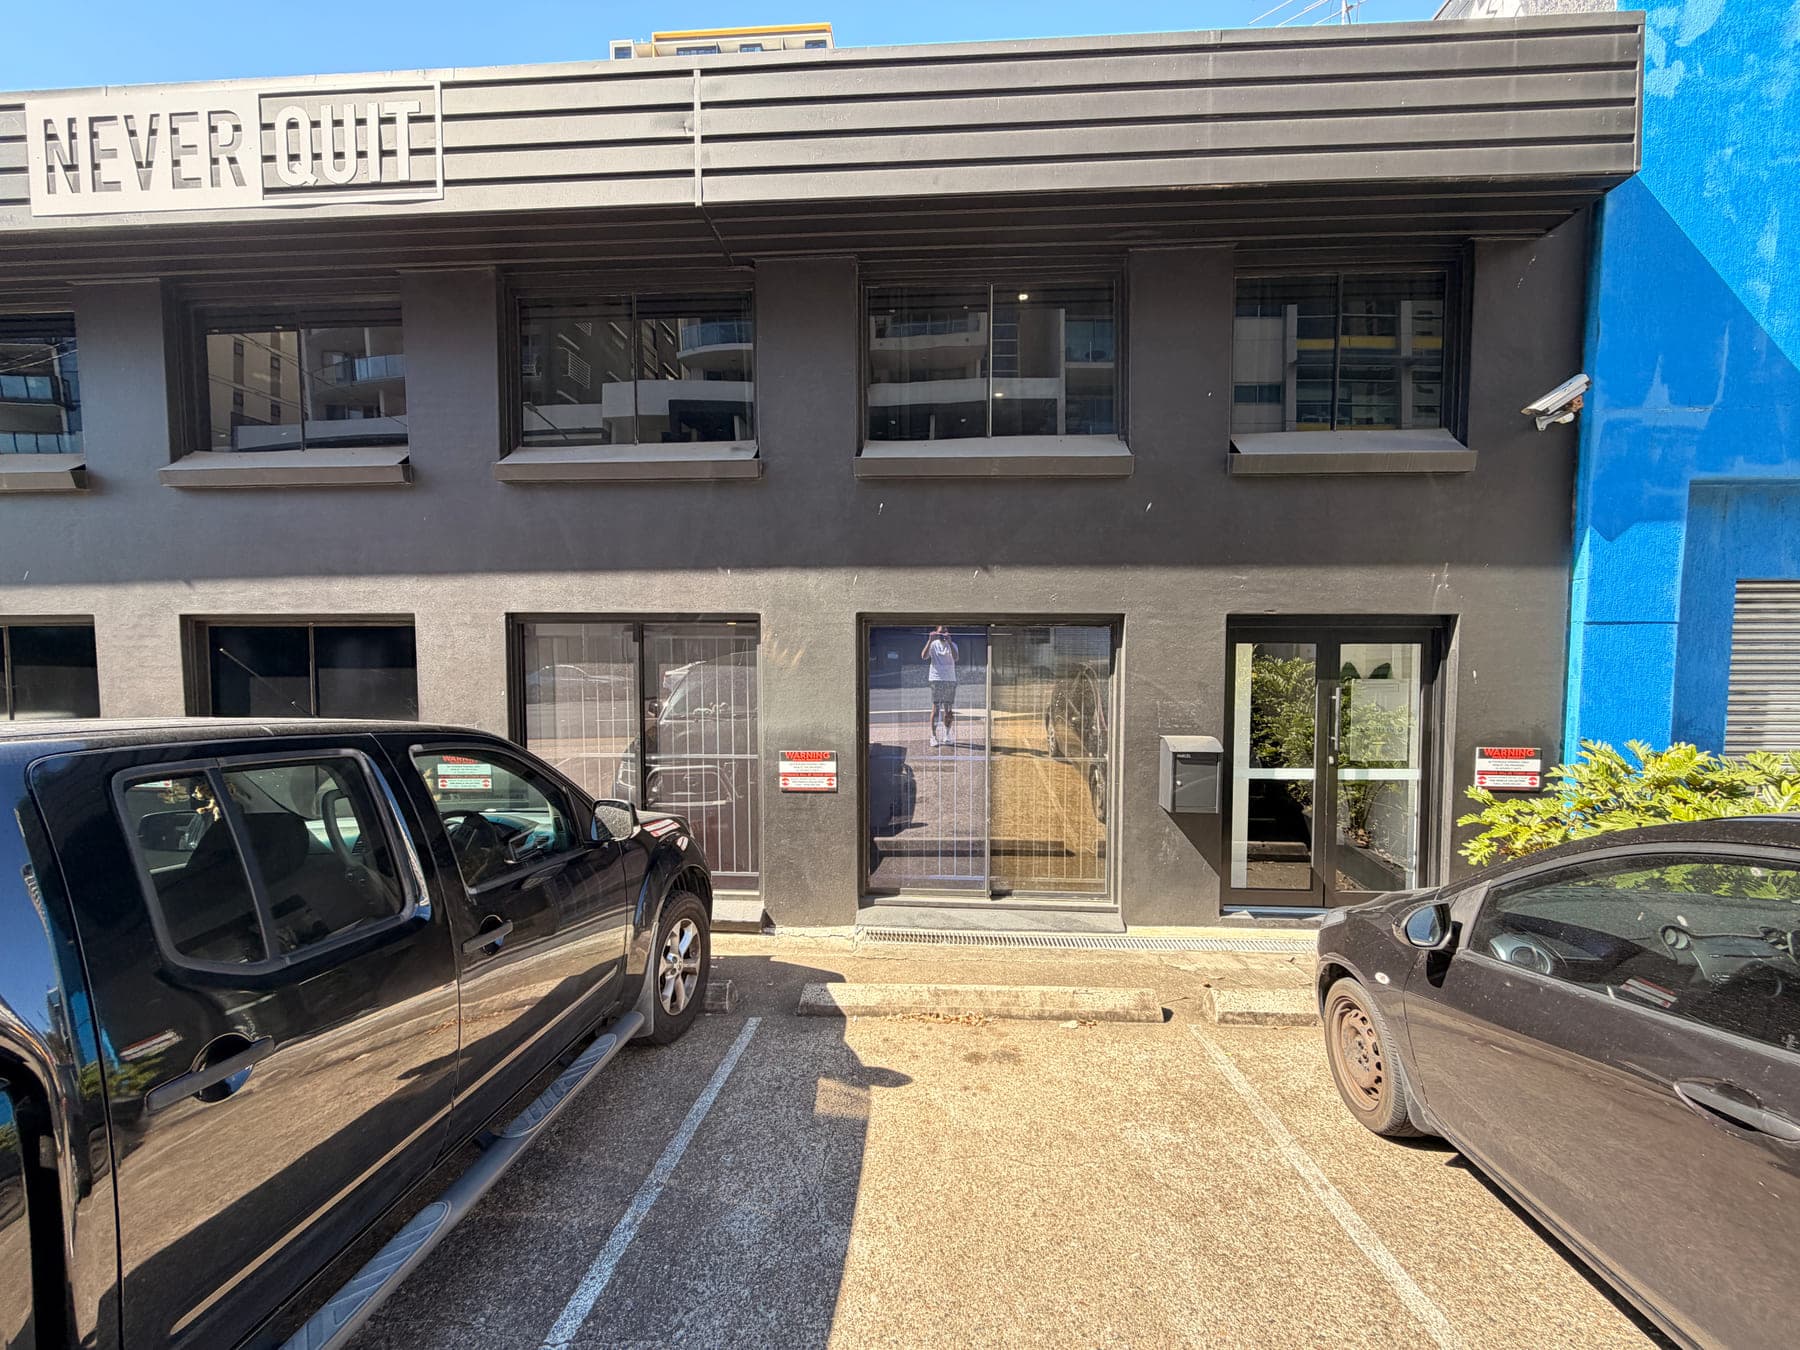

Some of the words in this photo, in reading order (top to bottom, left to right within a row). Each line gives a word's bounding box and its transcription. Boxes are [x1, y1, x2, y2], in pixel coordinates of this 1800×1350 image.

[44, 109, 247, 195] NEVER
[275, 101, 421, 186] QUIT
[785, 751, 831, 759] WARNING
[1484, 748, 1535, 757] WARNING
